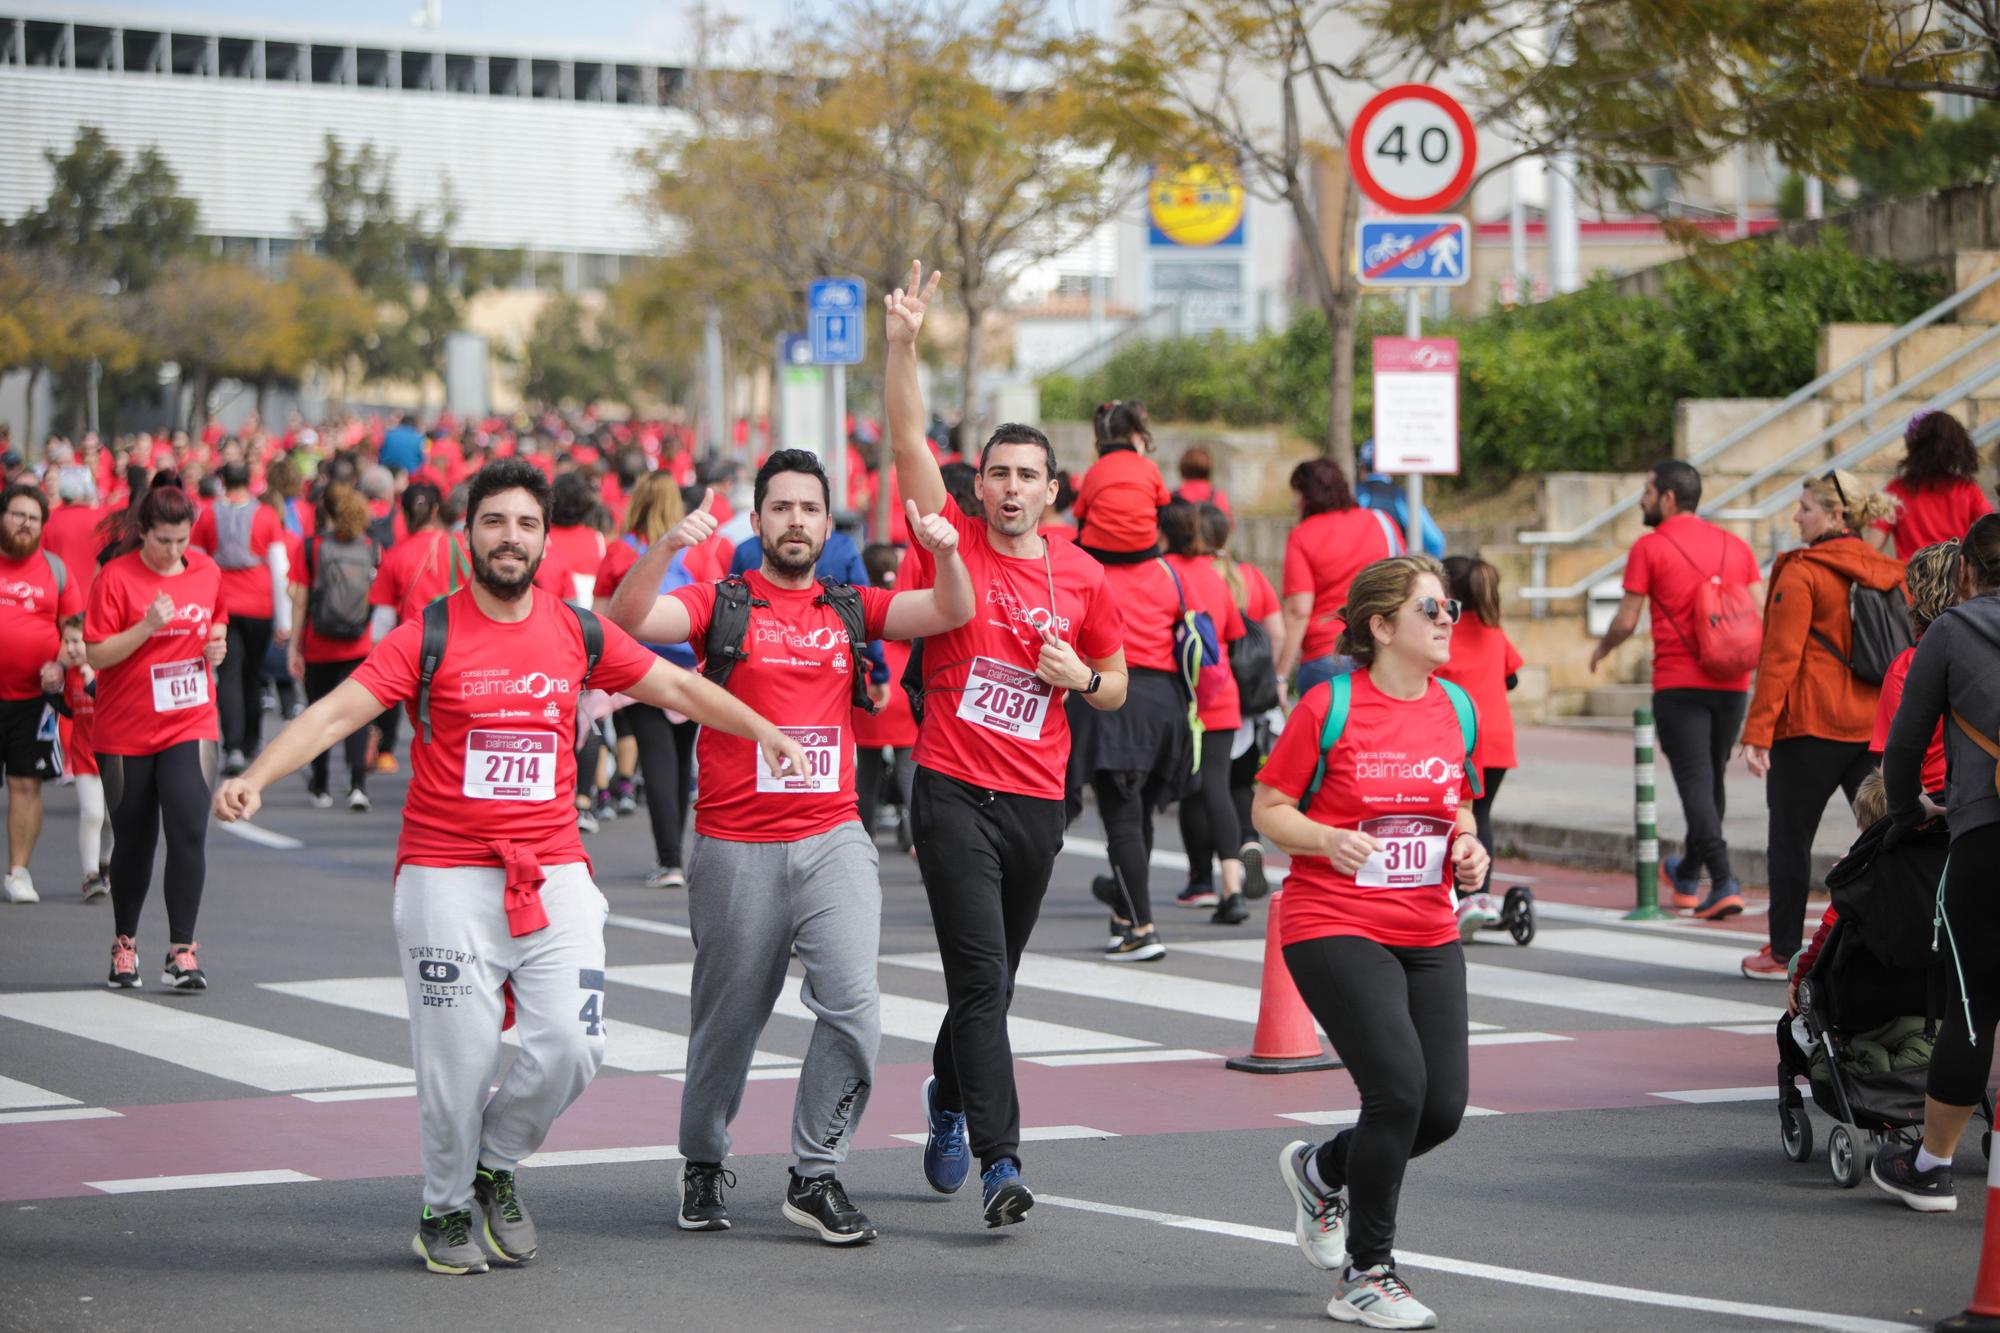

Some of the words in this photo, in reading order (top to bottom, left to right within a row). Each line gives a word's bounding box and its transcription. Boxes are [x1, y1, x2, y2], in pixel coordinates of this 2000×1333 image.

[1377, 125, 1449, 164] 40
[170, 677, 198, 697] 614
[543, 708, 560, 718] IME
[974, 681, 1040, 724] 2030
[485, 754, 540, 784] 2714
[1384, 840, 1427, 871] 310
[425, 963, 448, 979] 46
[419, 982, 473, 996] THLETIC
[422, 994, 459, 1008] DEPT.
[578, 993, 607, 1037] 4
